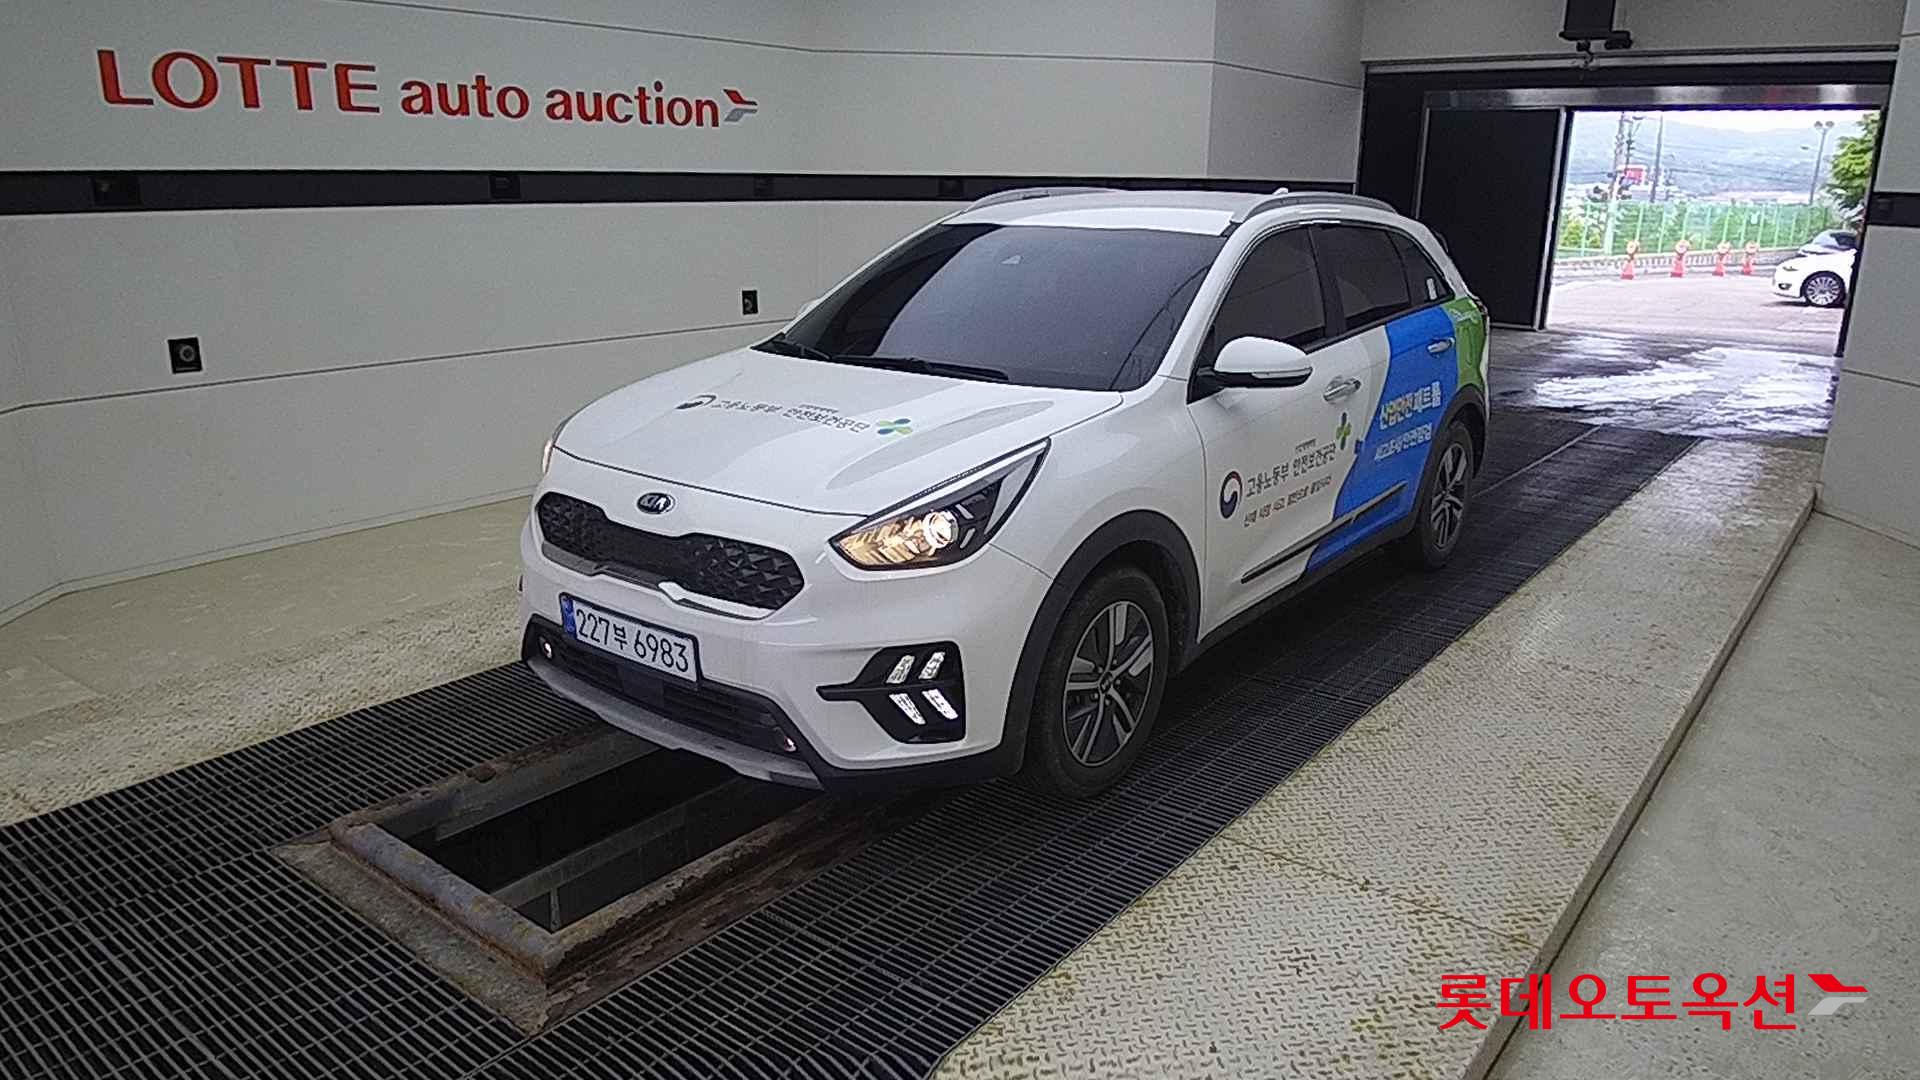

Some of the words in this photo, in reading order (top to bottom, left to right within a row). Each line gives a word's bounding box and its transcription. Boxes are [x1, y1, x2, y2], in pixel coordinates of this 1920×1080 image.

[97, 49, 380, 113] LOTTE
[400, 75, 529, 118] auto
[545, 81, 719, 127] auction
[1246, 462, 1289, 497] 고용노동부
[1292, 442, 1337, 477] 안전보건공단
[576, 608, 628, 650] 227부
[634, 629, 690, 674] 6983
